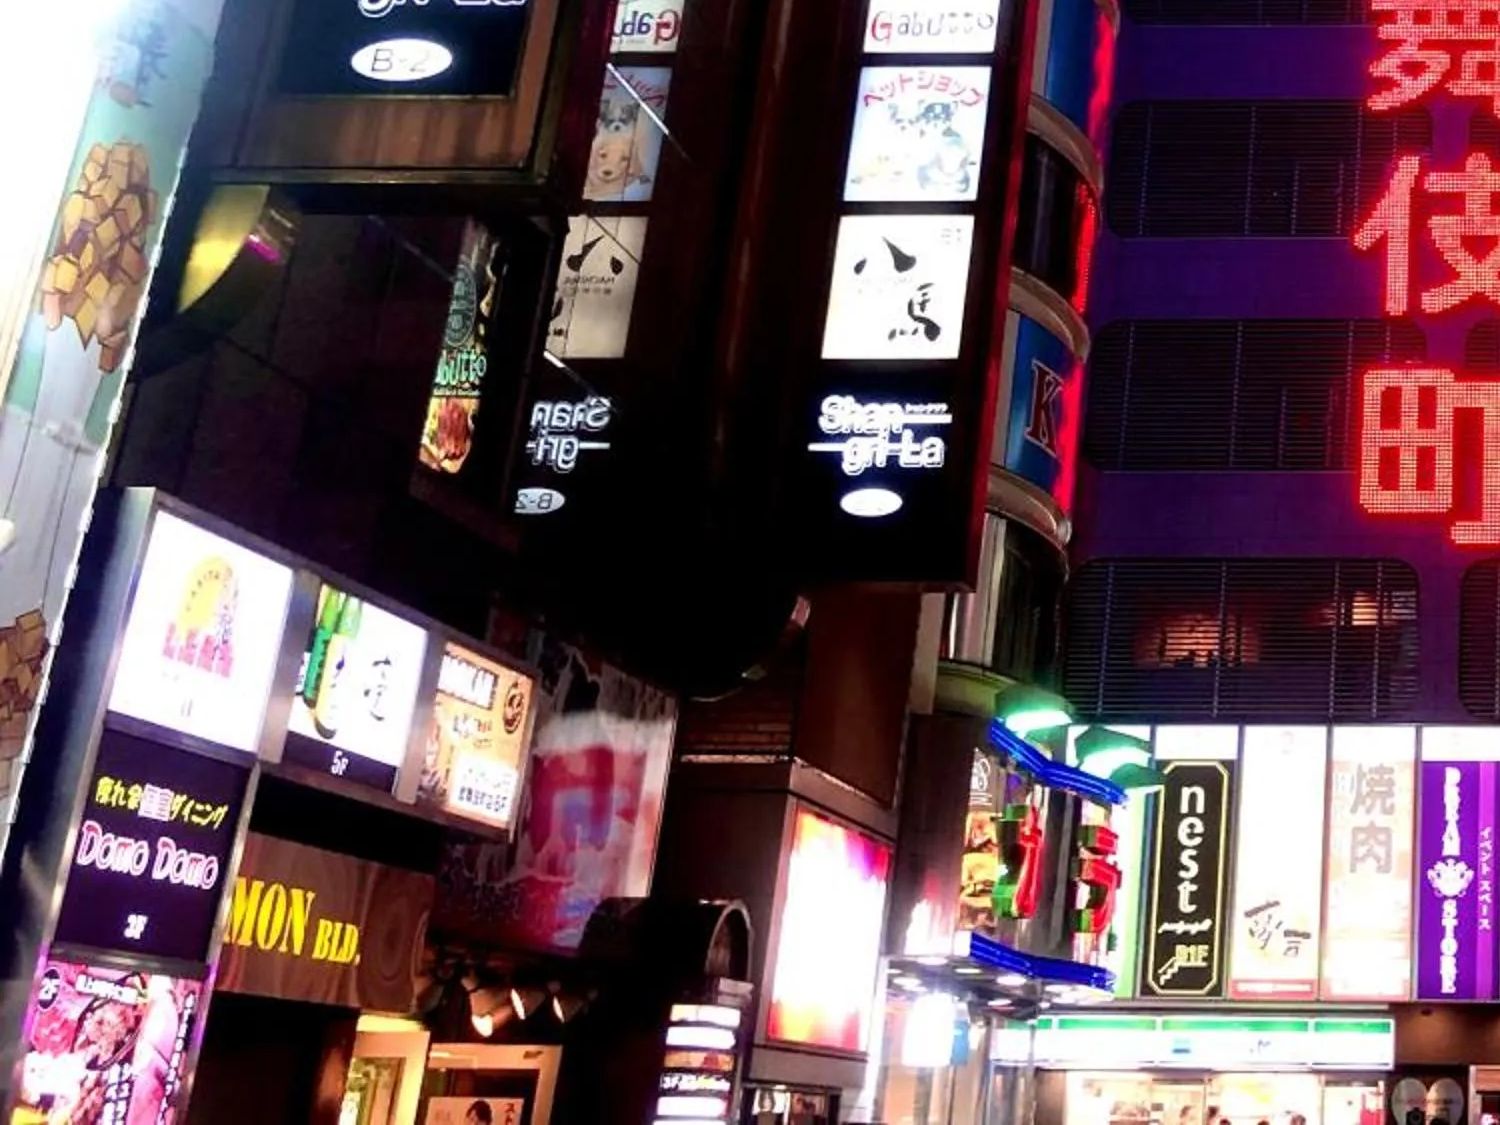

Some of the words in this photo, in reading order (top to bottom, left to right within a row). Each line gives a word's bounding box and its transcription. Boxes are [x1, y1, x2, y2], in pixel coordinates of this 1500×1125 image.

[1024, 358, 1064, 460] K
[330, 751, 350, 776] 5F
[1177, 784, 1206, 914] nest
[1349, 762, 1397, 875] 焼肉
[311, 918, 361, 964] BLD.
